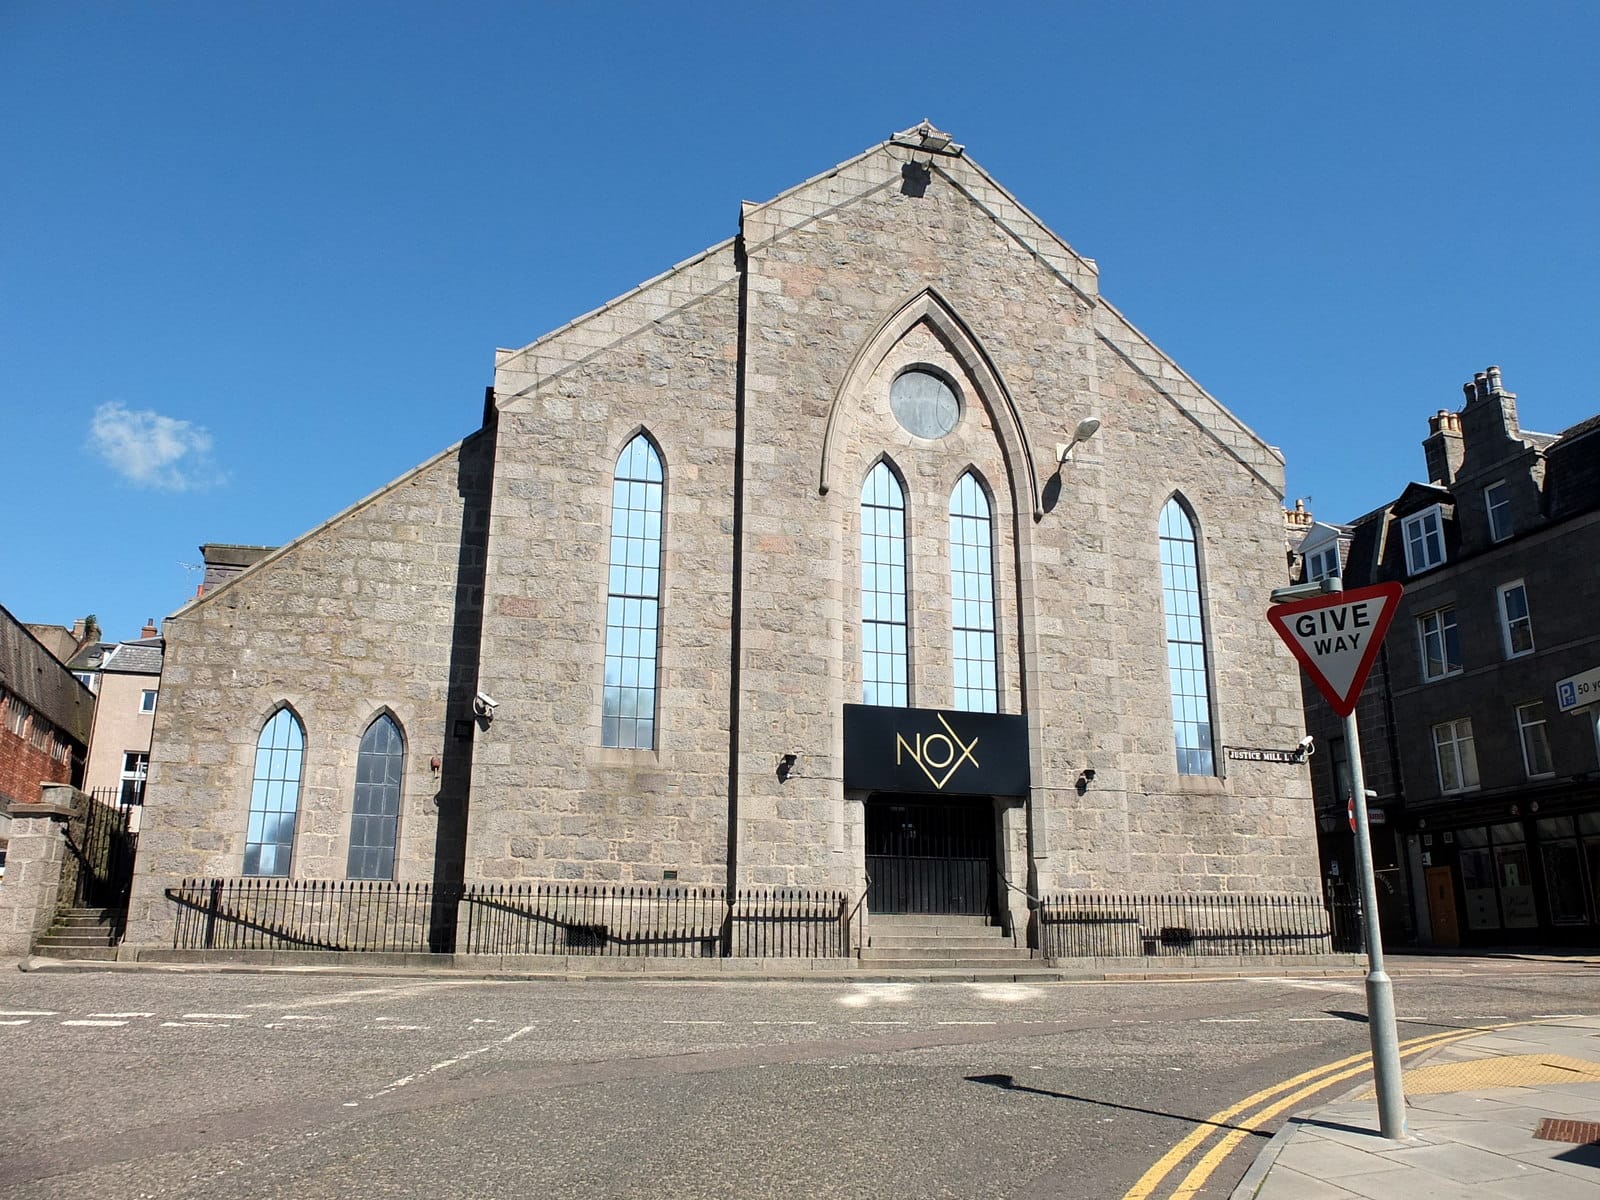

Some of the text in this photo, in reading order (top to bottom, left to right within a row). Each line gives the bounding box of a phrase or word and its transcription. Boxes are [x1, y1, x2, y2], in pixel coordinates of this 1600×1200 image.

[1295, 603, 1371, 638] GIVE
[1314, 633, 1361, 656] WAY
[896, 712, 980, 790] NOX
[1229, 751, 1261, 760] JUSTICE
[1263, 752, 1282, 761] MILL
